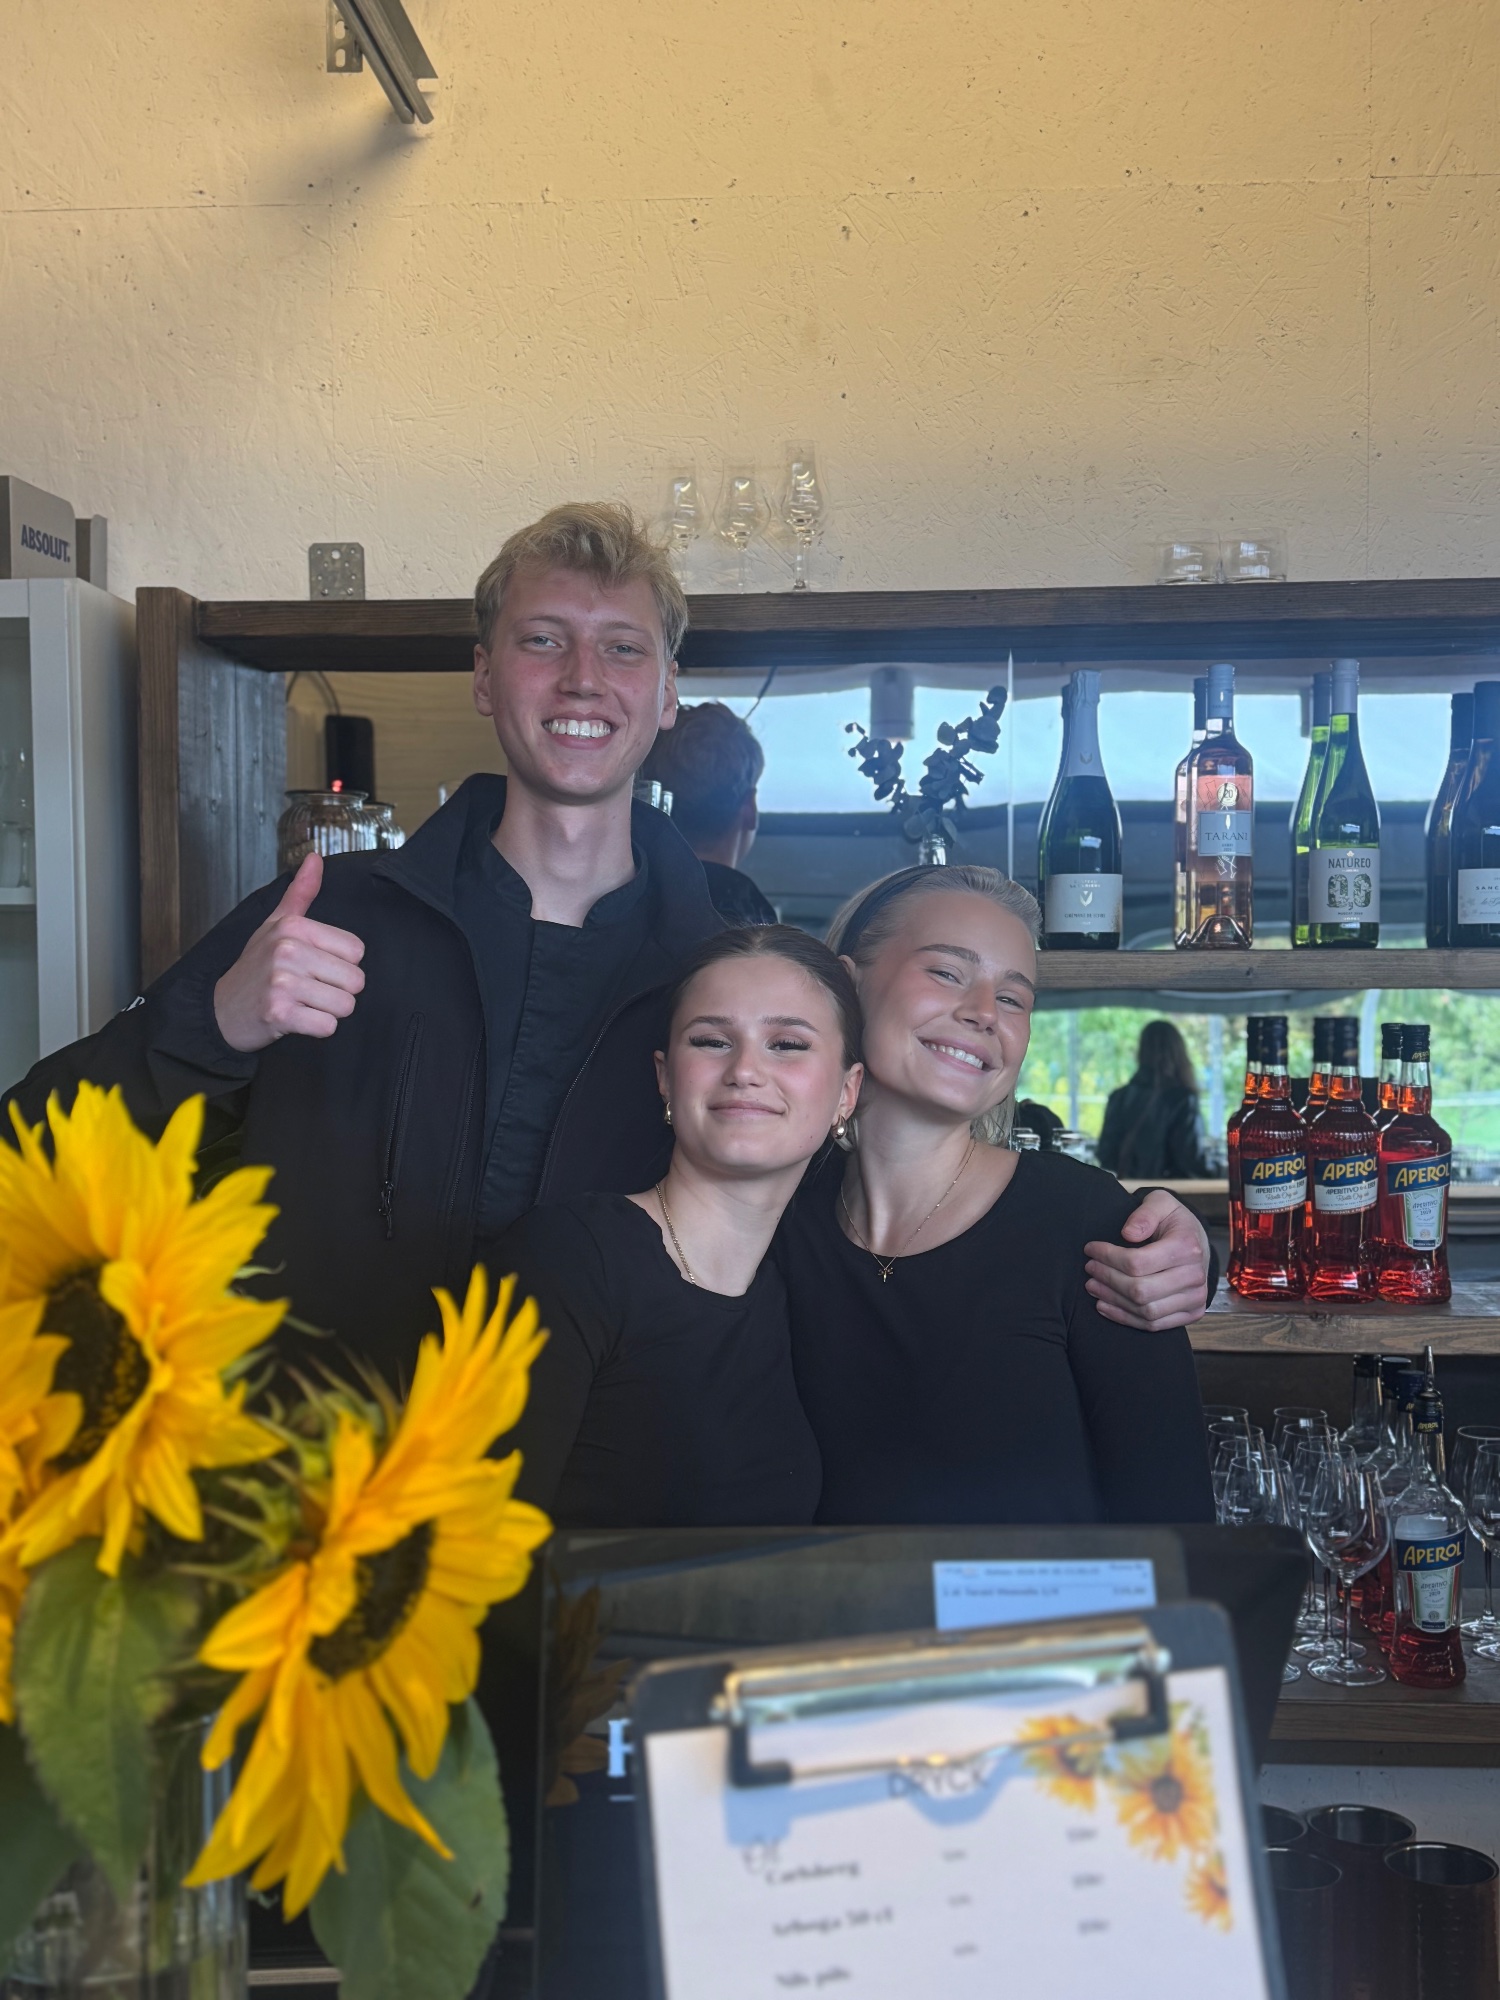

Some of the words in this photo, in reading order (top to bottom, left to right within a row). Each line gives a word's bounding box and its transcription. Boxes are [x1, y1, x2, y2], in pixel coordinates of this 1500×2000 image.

[1204, 832, 1249, 841] TARANI
[1328, 857, 1371, 869] NATUREO
[1251, 1155, 1307, 1180] APEROL
[1322, 1156, 1378, 1181] APEROL
[1394, 1162, 1450, 1189] APEROL
[1255, 1185, 1288, 1194] APERITIVO
[1325, 1185, 1360, 1196] APERITIVO
[1412, 1199, 1438, 1209] APERITIVO
[1402, 1541, 1462, 1566] APEROL
[1420, 1580, 1448, 1590] APERITIVO
